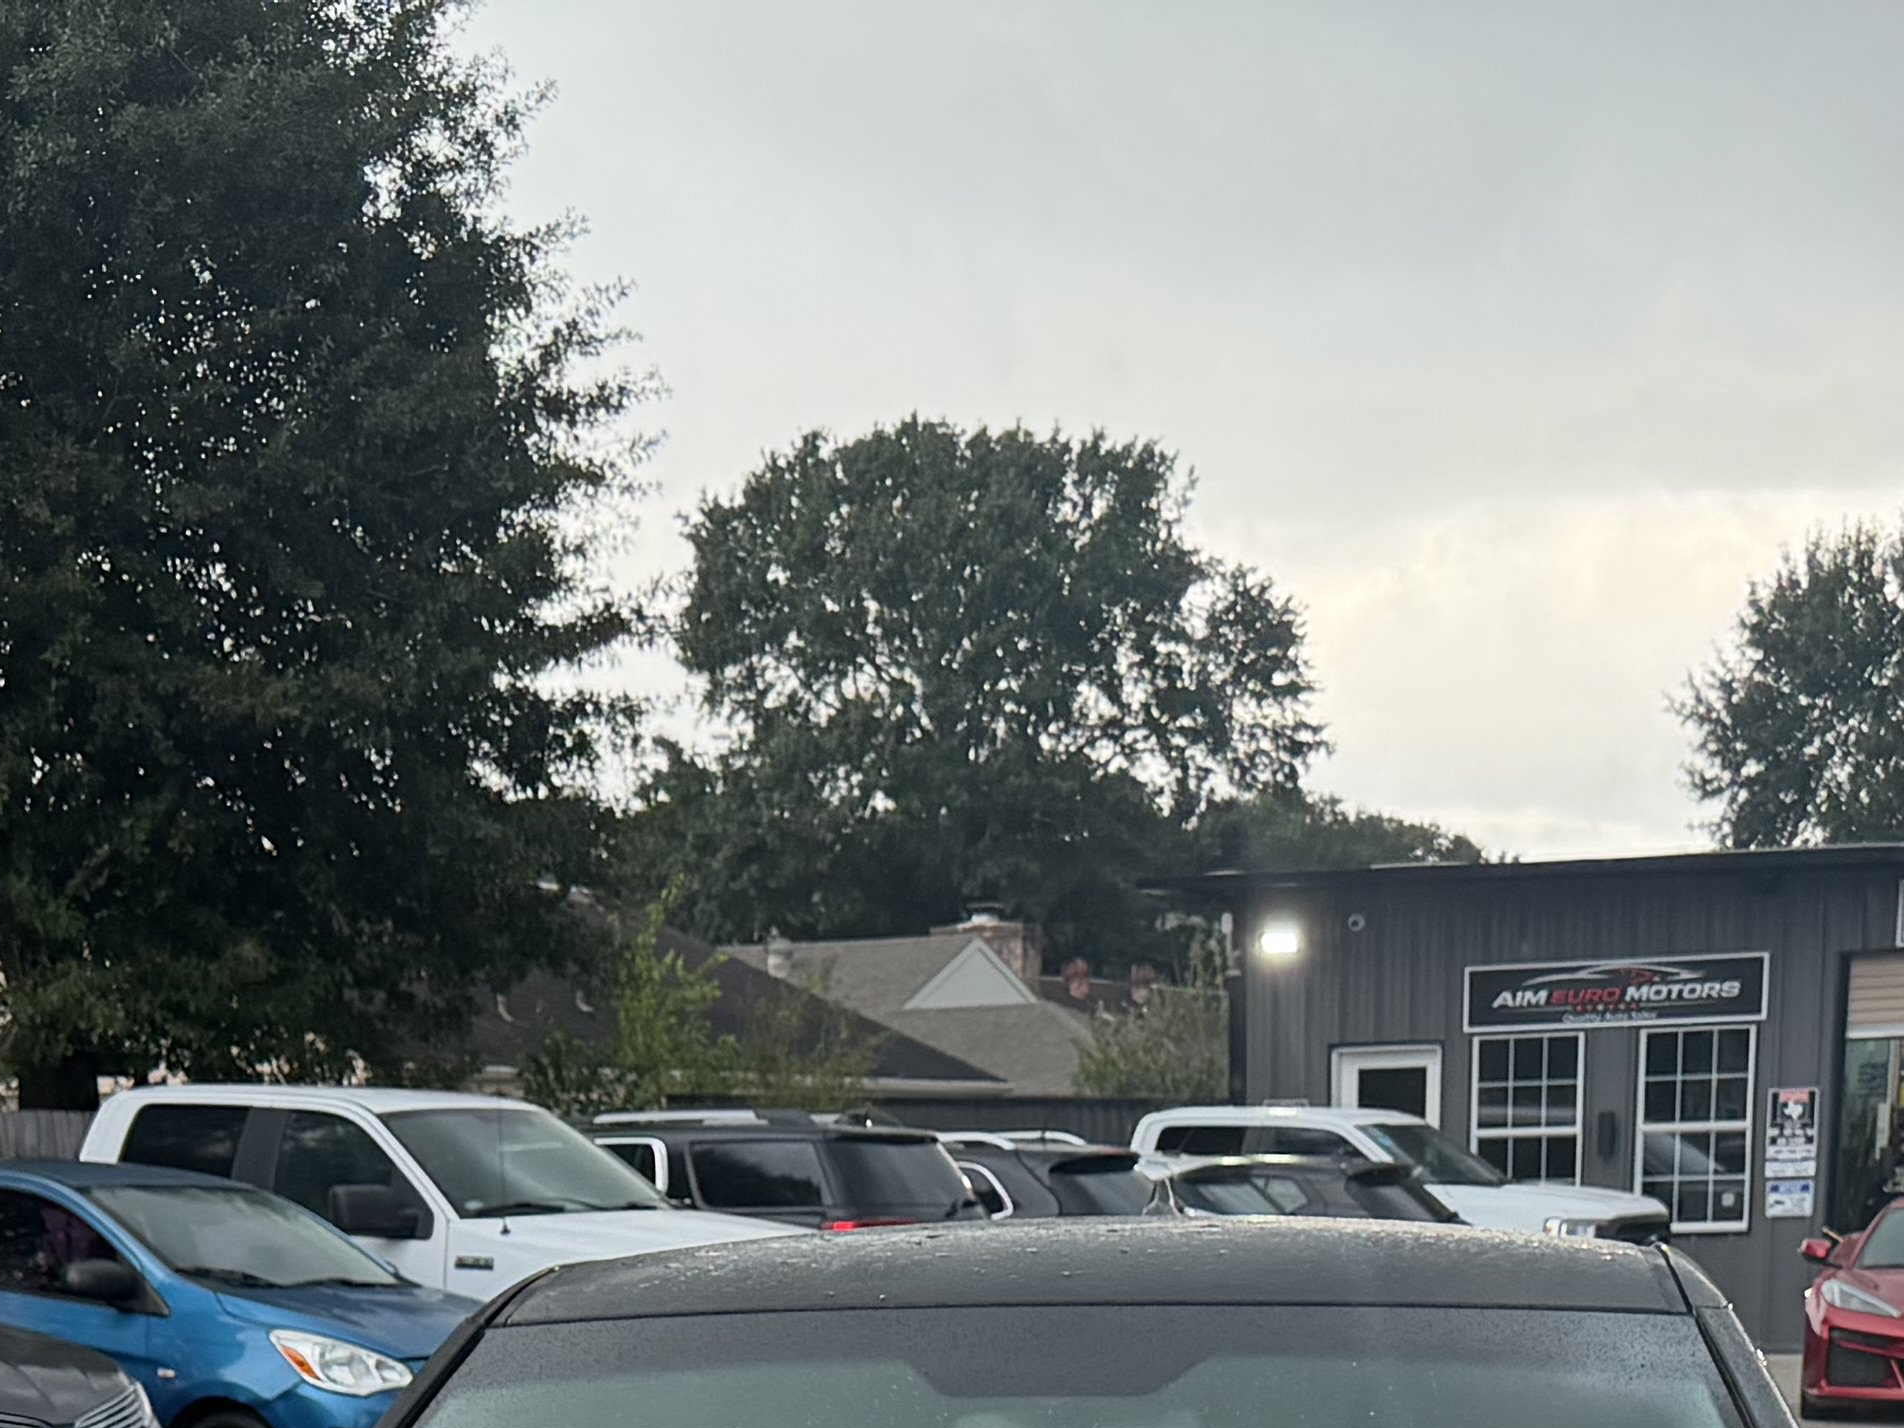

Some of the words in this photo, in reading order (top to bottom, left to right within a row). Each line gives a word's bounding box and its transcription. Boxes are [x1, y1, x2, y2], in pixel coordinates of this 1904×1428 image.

[1492, 988, 1549, 1009] AIM
[1550, 986, 1622, 1005] EURO
[1624, 980, 1741, 1001] MOTORS
